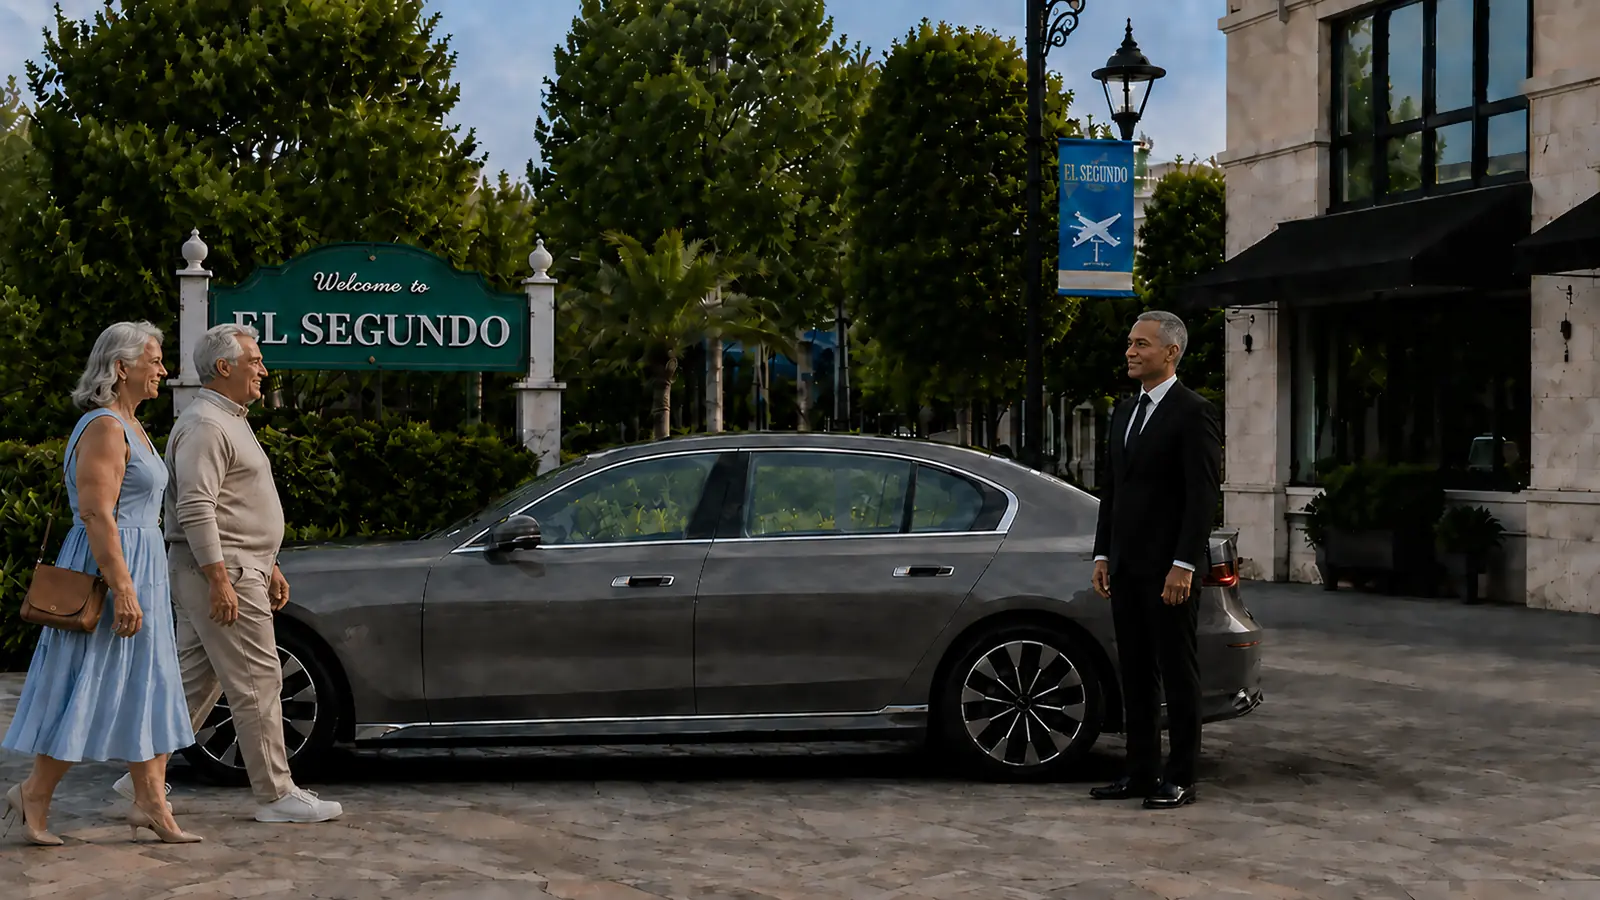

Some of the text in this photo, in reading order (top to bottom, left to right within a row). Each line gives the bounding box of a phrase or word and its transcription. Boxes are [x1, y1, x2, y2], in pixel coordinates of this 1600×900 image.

[1064, 163, 1128, 183] EL SEGUNDO
[313, 271, 430, 293] Welcome to
[300, 312, 510, 347] SEGUNDO
